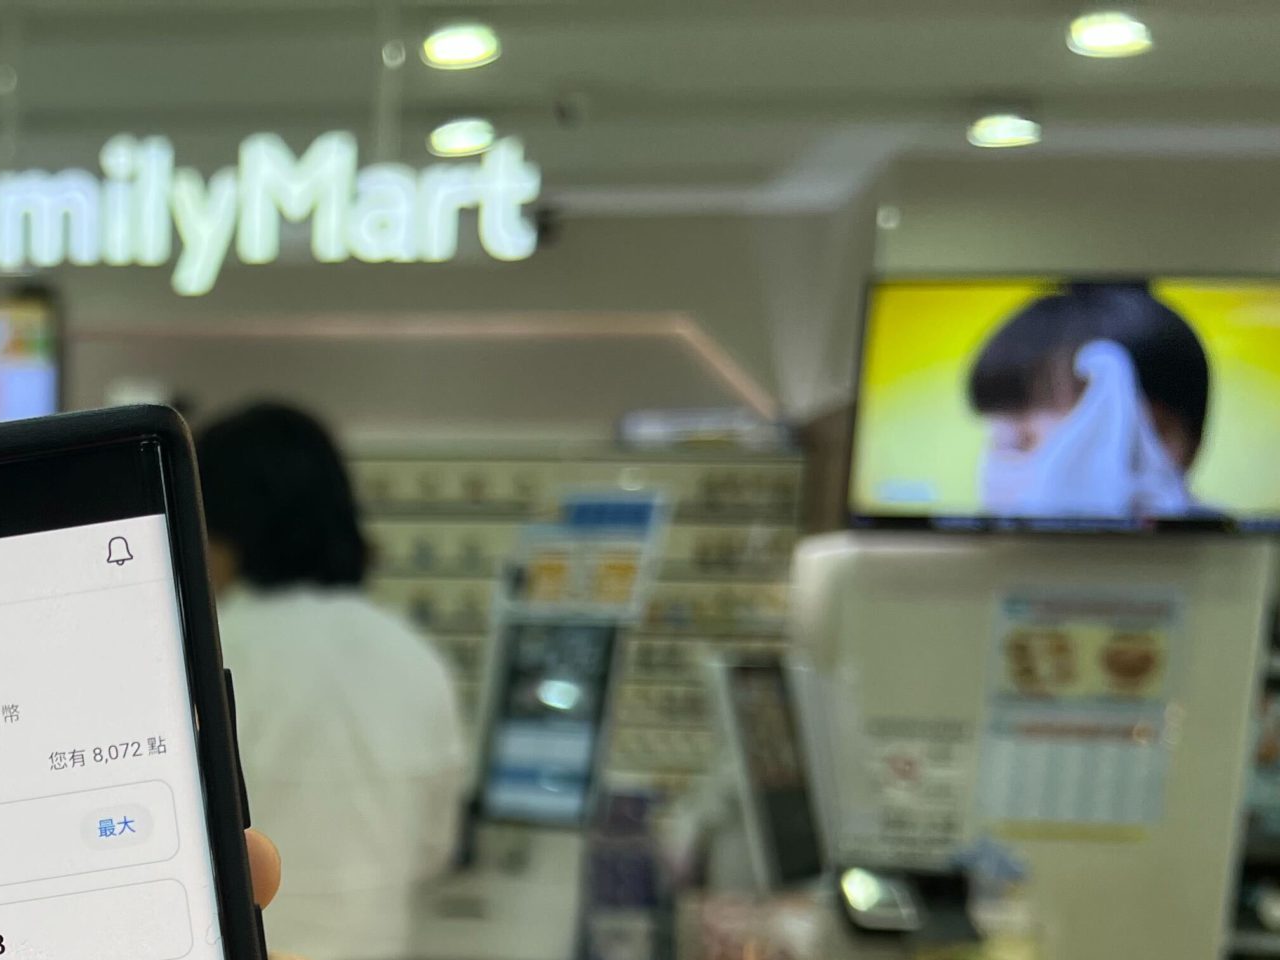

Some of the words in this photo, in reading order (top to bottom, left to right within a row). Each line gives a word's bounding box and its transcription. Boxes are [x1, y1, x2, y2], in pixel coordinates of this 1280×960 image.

[48, 748, 87, 772] 您有
[92, 740, 143, 766] 8,072
[147, 735, 167, 756] 點
[97, 816, 136, 837] 最大
